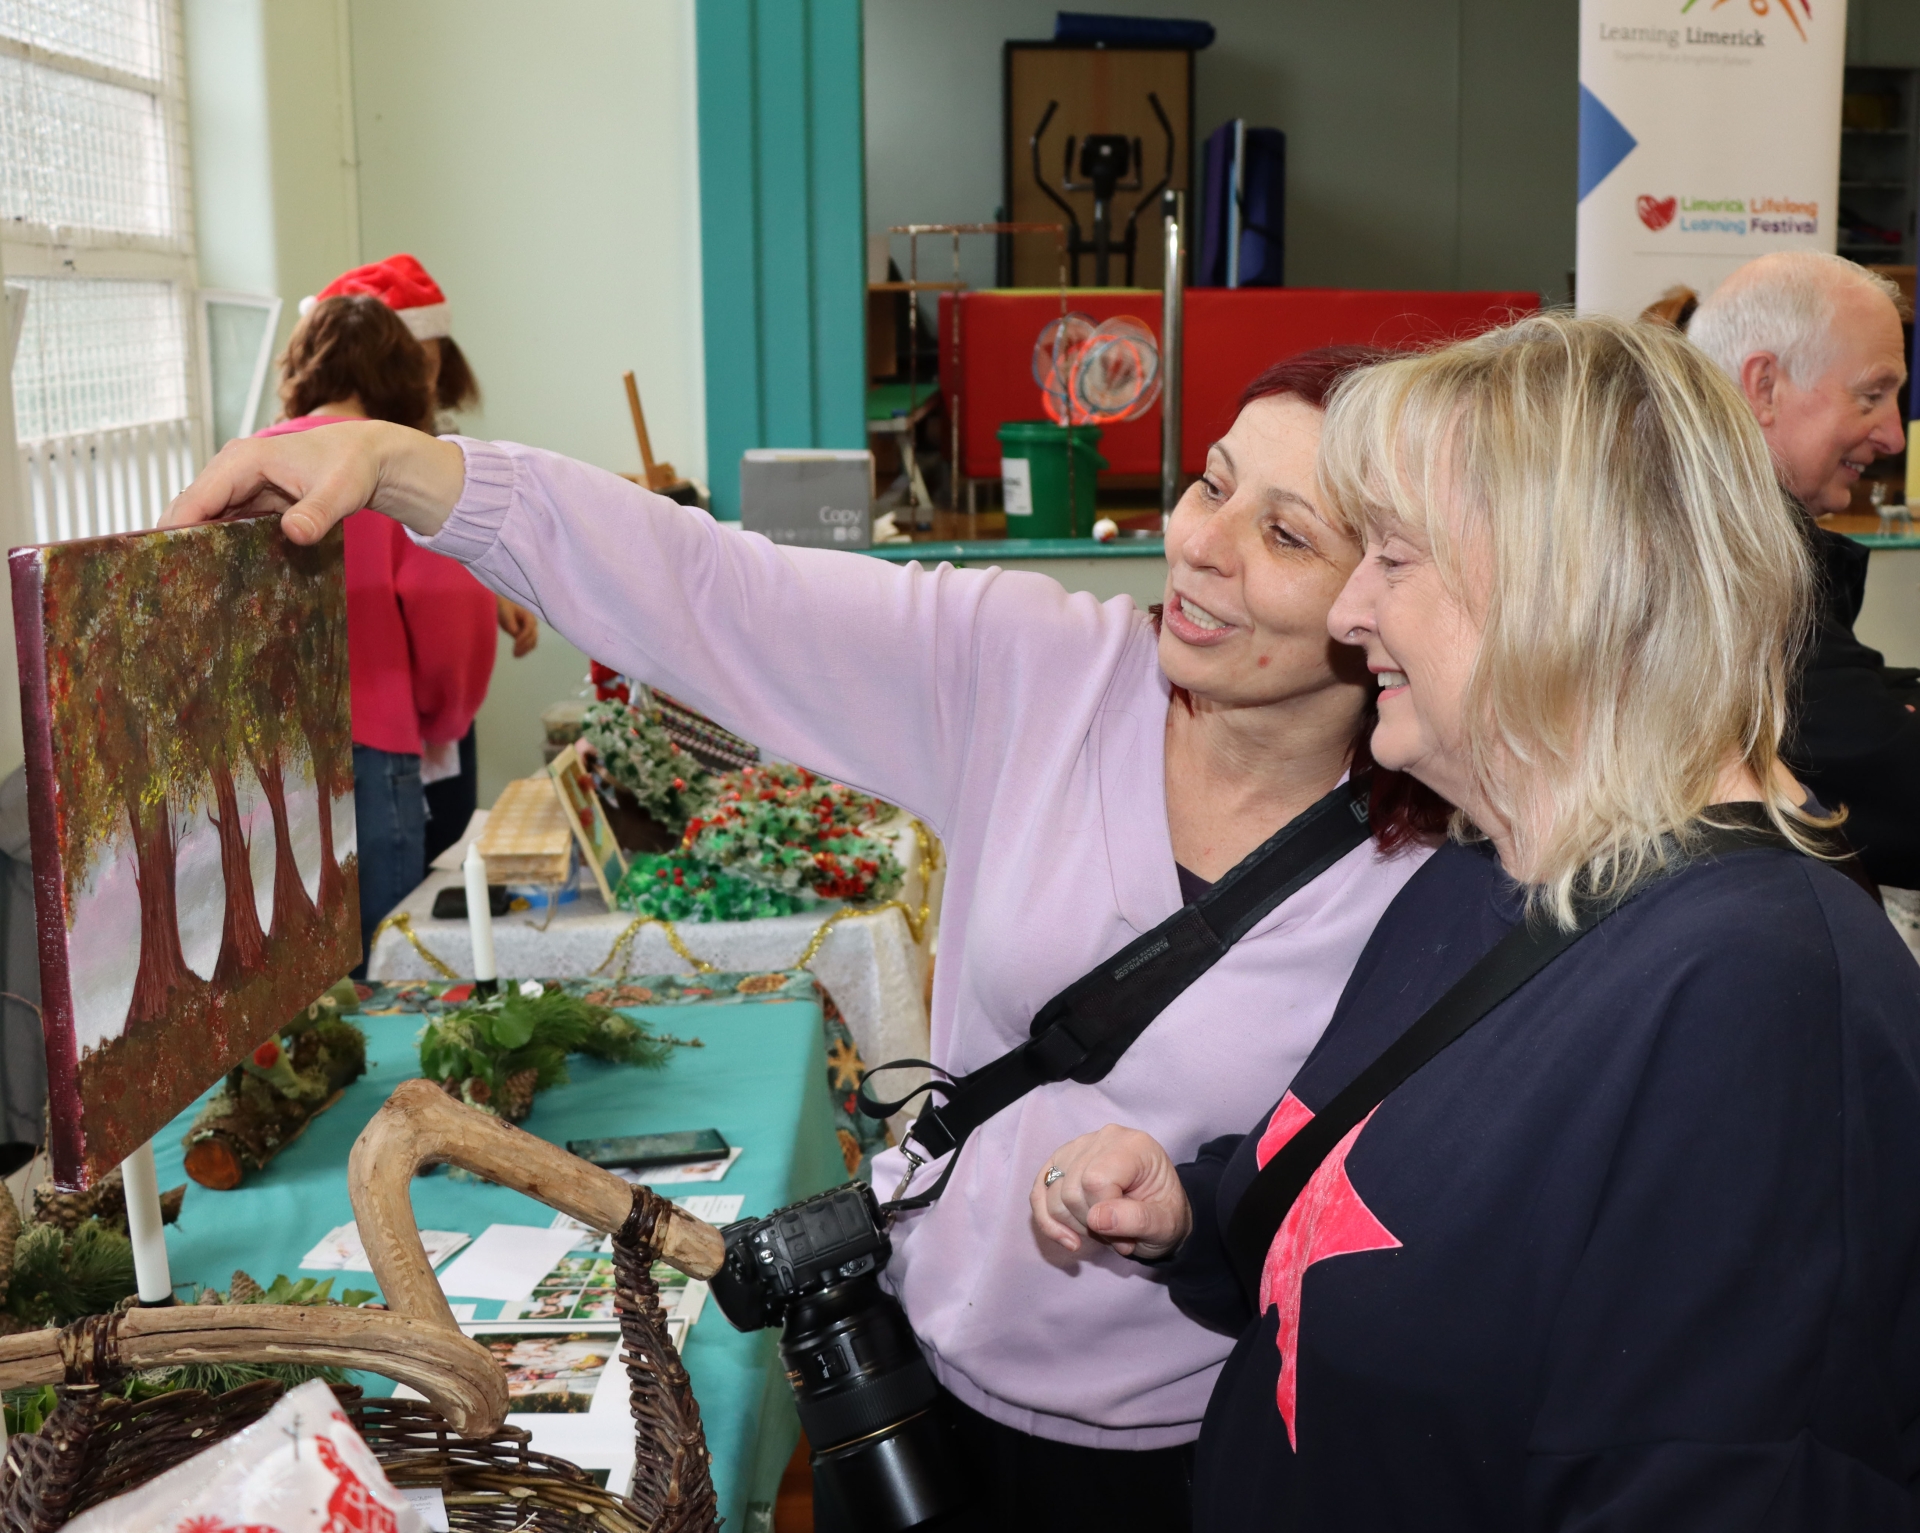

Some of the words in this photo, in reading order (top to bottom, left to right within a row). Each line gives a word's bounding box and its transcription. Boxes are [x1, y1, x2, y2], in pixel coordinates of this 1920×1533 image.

[1600, 23, 1679, 48] Learning
[1685, 26, 1765, 47] Limerick
[1680, 196, 1746, 213] Limerick
[1751, 197, 1818, 217] Lifelong
[1680, 217, 1746, 235] Learning
[1751, 217, 1818, 234] Festival
[819, 505, 862, 524] Copy
[1115, 941, 1169, 980] BLACKRAPID.COM
